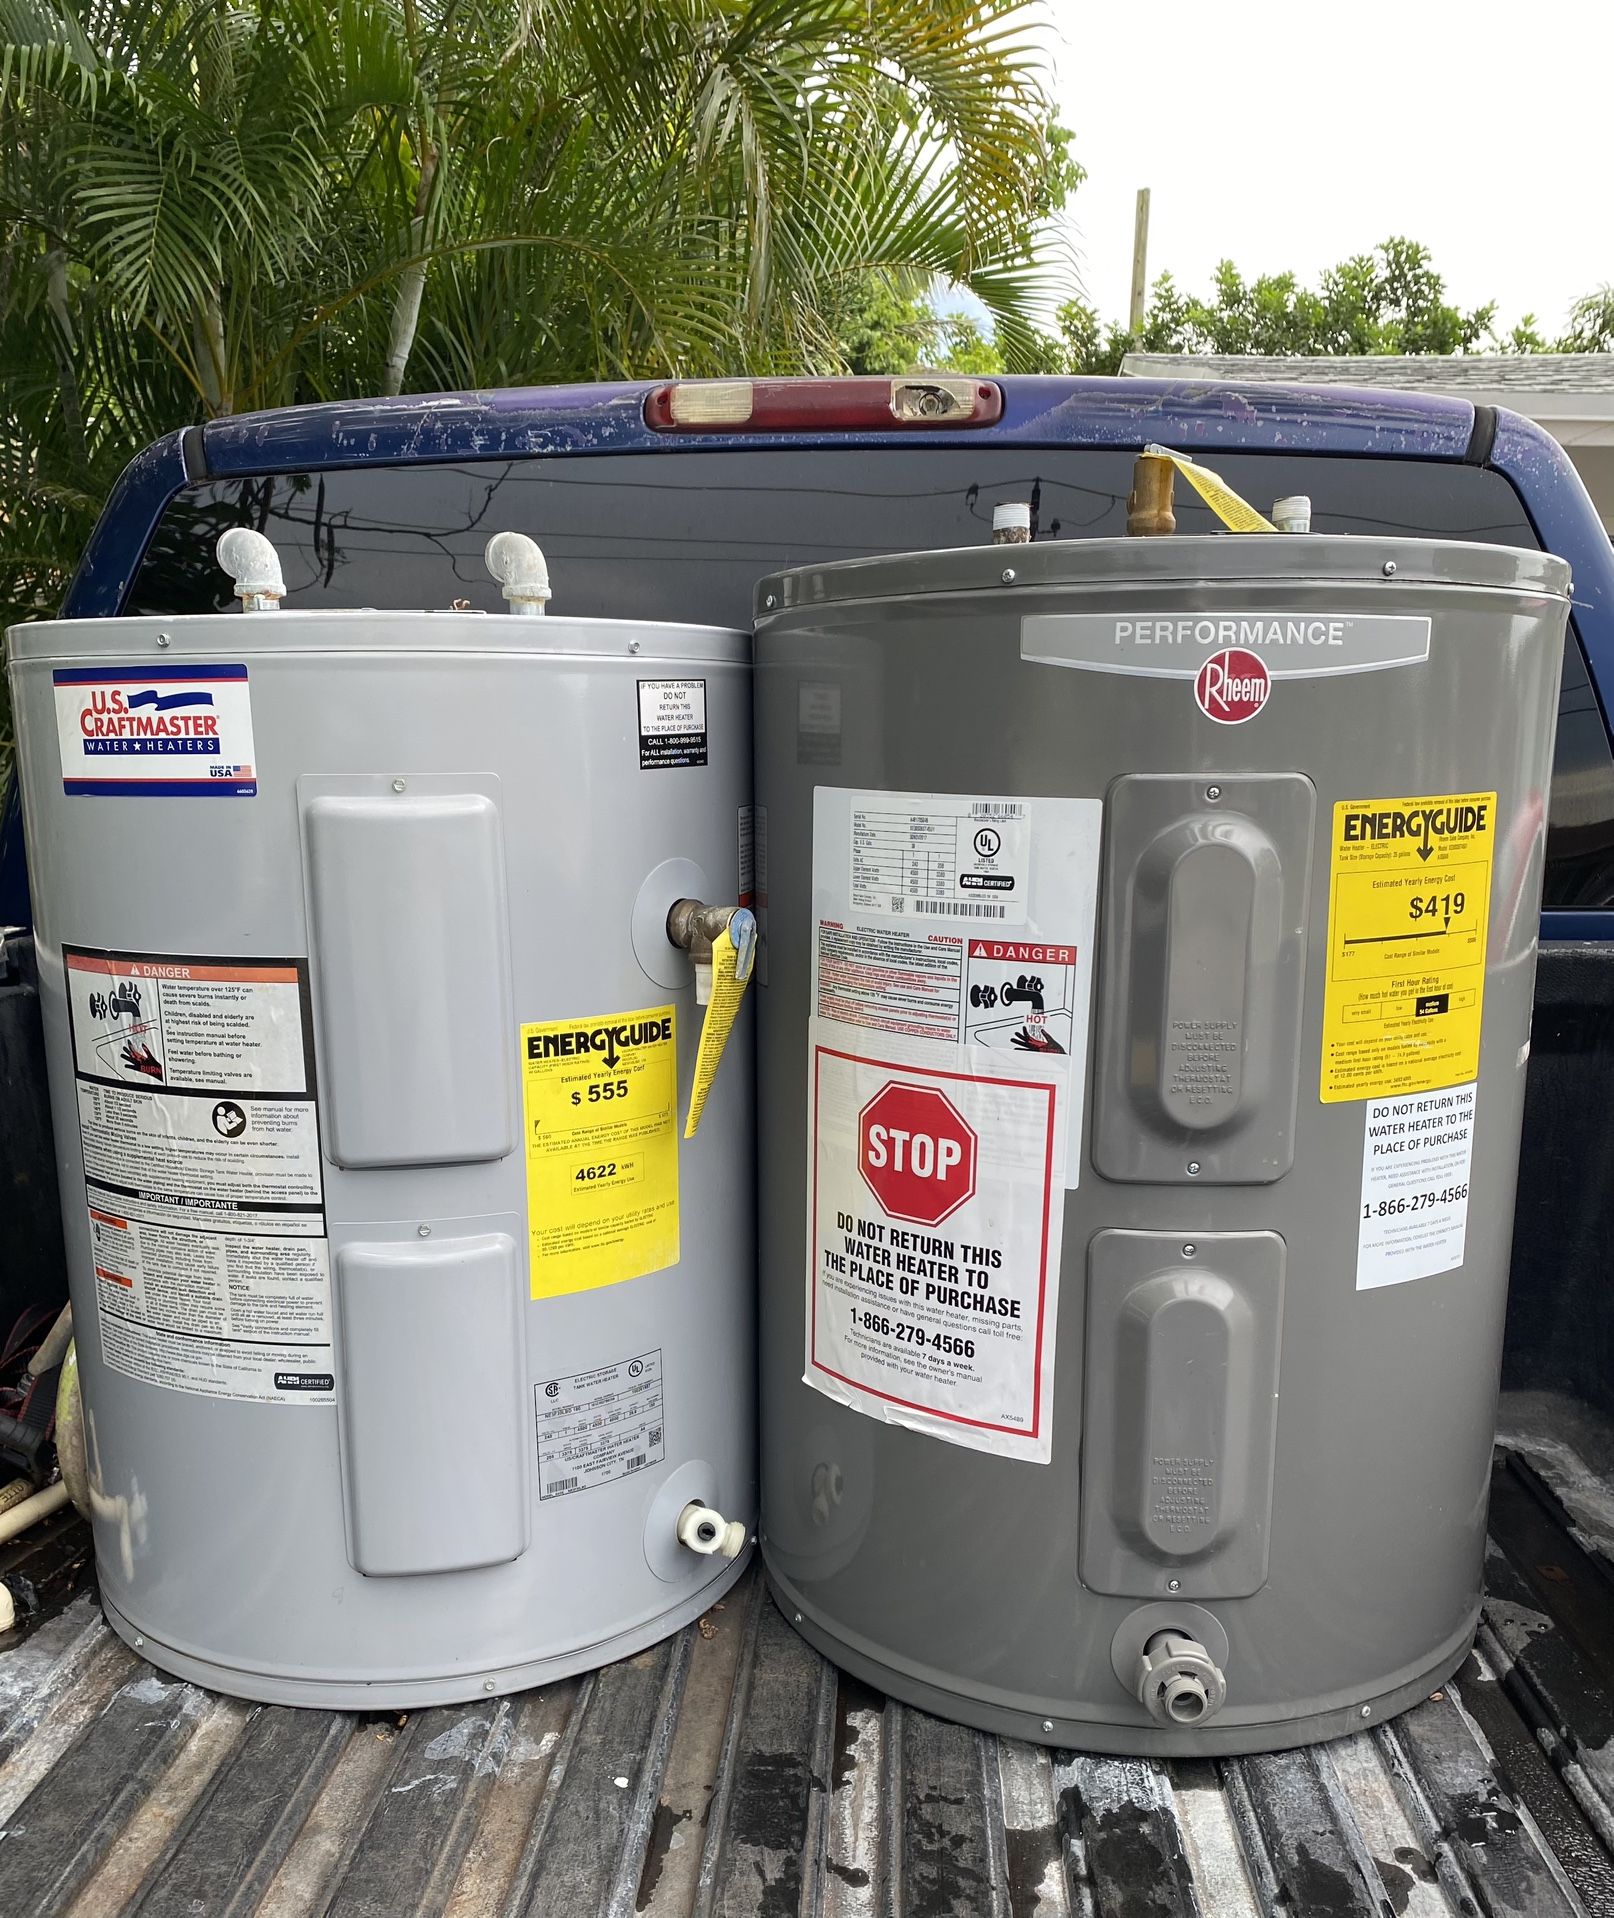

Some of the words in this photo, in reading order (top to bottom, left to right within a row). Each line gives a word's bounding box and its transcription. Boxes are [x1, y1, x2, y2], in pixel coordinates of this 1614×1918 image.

[1114, 621, 1343, 646] PERFORMANCE
[1205, 652, 1266, 712] Rheem
[92, 690, 129, 715] U.S.
[664, 692, 673, 700] DO
[81, 709, 219, 737] CRAFTMASTER
[86, 741, 128, 751] WATER
[147, 740, 214, 750] HEATERS
[1344, 805, 1487, 844] ENERGYGUIDE
[981, 835, 994, 851] UL
[1373, 880, 1402, 888] Estimated
[1405, 878, 1423, 887] Yearly
[1425, 876, 1443, 885] Energy
[1410, 892, 1465, 921] $419
[820, 920, 843, 929] WARNING
[857, 926, 876, 934] ELECTRIC
[928, 935, 963, 944] CAUTION
[994, 947, 1069, 962] DANGER
[144, 965, 190, 979] DANGER
[1392, 980, 1405, 988] First
[1407, 979, 1420, 987] Hour
[1422, 977, 1439, 986] Rating
[1026, 1015, 1048, 1025] HOT
[1204, 1021, 1237, 1030] SUPPLY
[528, 1018, 672, 1061] ENERGYGUIDE
[1187, 1054, 1220, 1062] BEFORE
[141, 1065, 162, 1074] BURN
[561, 1074, 592, 1083] Estimated
[594, 1071, 612, 1079] Yearly
[571, 1091, 581, 1106] $
[588, 1080, 629, 1103] 555
[1373, 1107, 1389, 1119] DO
[1393, 1102, 1413, 1117] NOT
[1417, 1097, 1453, 1113] RETURN
[1456, 1092, 1473, 1104] THIS
[1369, 1122, 1405, 1138] WATER
[1408, 1117, 1443, 1133] HEATER
[1446, 1114, 1456, 1125] TO
[1459, 1110, 1473, 1122] THE
[1374, 1140, 1405, 1155] PLACE
[1408, 1137, 1421, 1149] OF
[1424, 1129, 1468, 1148] PURCHASE
[868, 1124, 962, 1181] STOP
[575, 1163, 617, 1181] 4622
[139, 1191, 179, 1205] IMPORTANT
[185, 1198, 238, 1210] IMPORTANTE
[1363, 1183, 1468, 1219] 1-866-279-4566
[577, 1220, 601, 1229] depend
[838, 1212, 853, 1233] DO
[857, 1219, 886, 1243] NOT
[890, 1229, 955, 1260] RETURN
[961, 1245, 1002, 1268] THIS
[844, 1236, 891, 1268] WATER
[896, 1253, 959, 1284] HEATER
[965, 1268, 988, 1290] TO
[824, 1249, 846, 1274] THE
[850, 1261, 894, 1291] PLACE
[900, 1276, 919, 1296] OF
[926, 1282, 1020, 1318] PURCHASE
[850, 1308, 975, 1358] 1-866-279-4566
[845, 1335, 853, 1344] For
[854, 1339, 868, 1350] more
[869, 1344, 902, 1362] information,
[904, 1358, 915, 1367] see
[917, 1360, 928, 1370] the
[929, 1365, 955, 1377] owner's
[957, 1372, 982, 1383] manual
[850, 1328, 881, 1346] Technicians
[883, 1341, 892, 1350] are
[894, 1345, 920, 1359] available
[928, 1355, 945, 1366] days
[954, 1362, 975, 1372] week.
[575, 1375, 596, 1383] ELECTRIC
[602, 1374, 619, 1383] HEATER
[861, 1352, 885, 1366] provided
[887, 1361, 899, 1370] with
[900, 1366, 914, 1376] your
[915, 1370, 933, 1381] water
[934, 1375, 958, 1387] heater.
[593, 1450, 615, 1459] COMPANY
